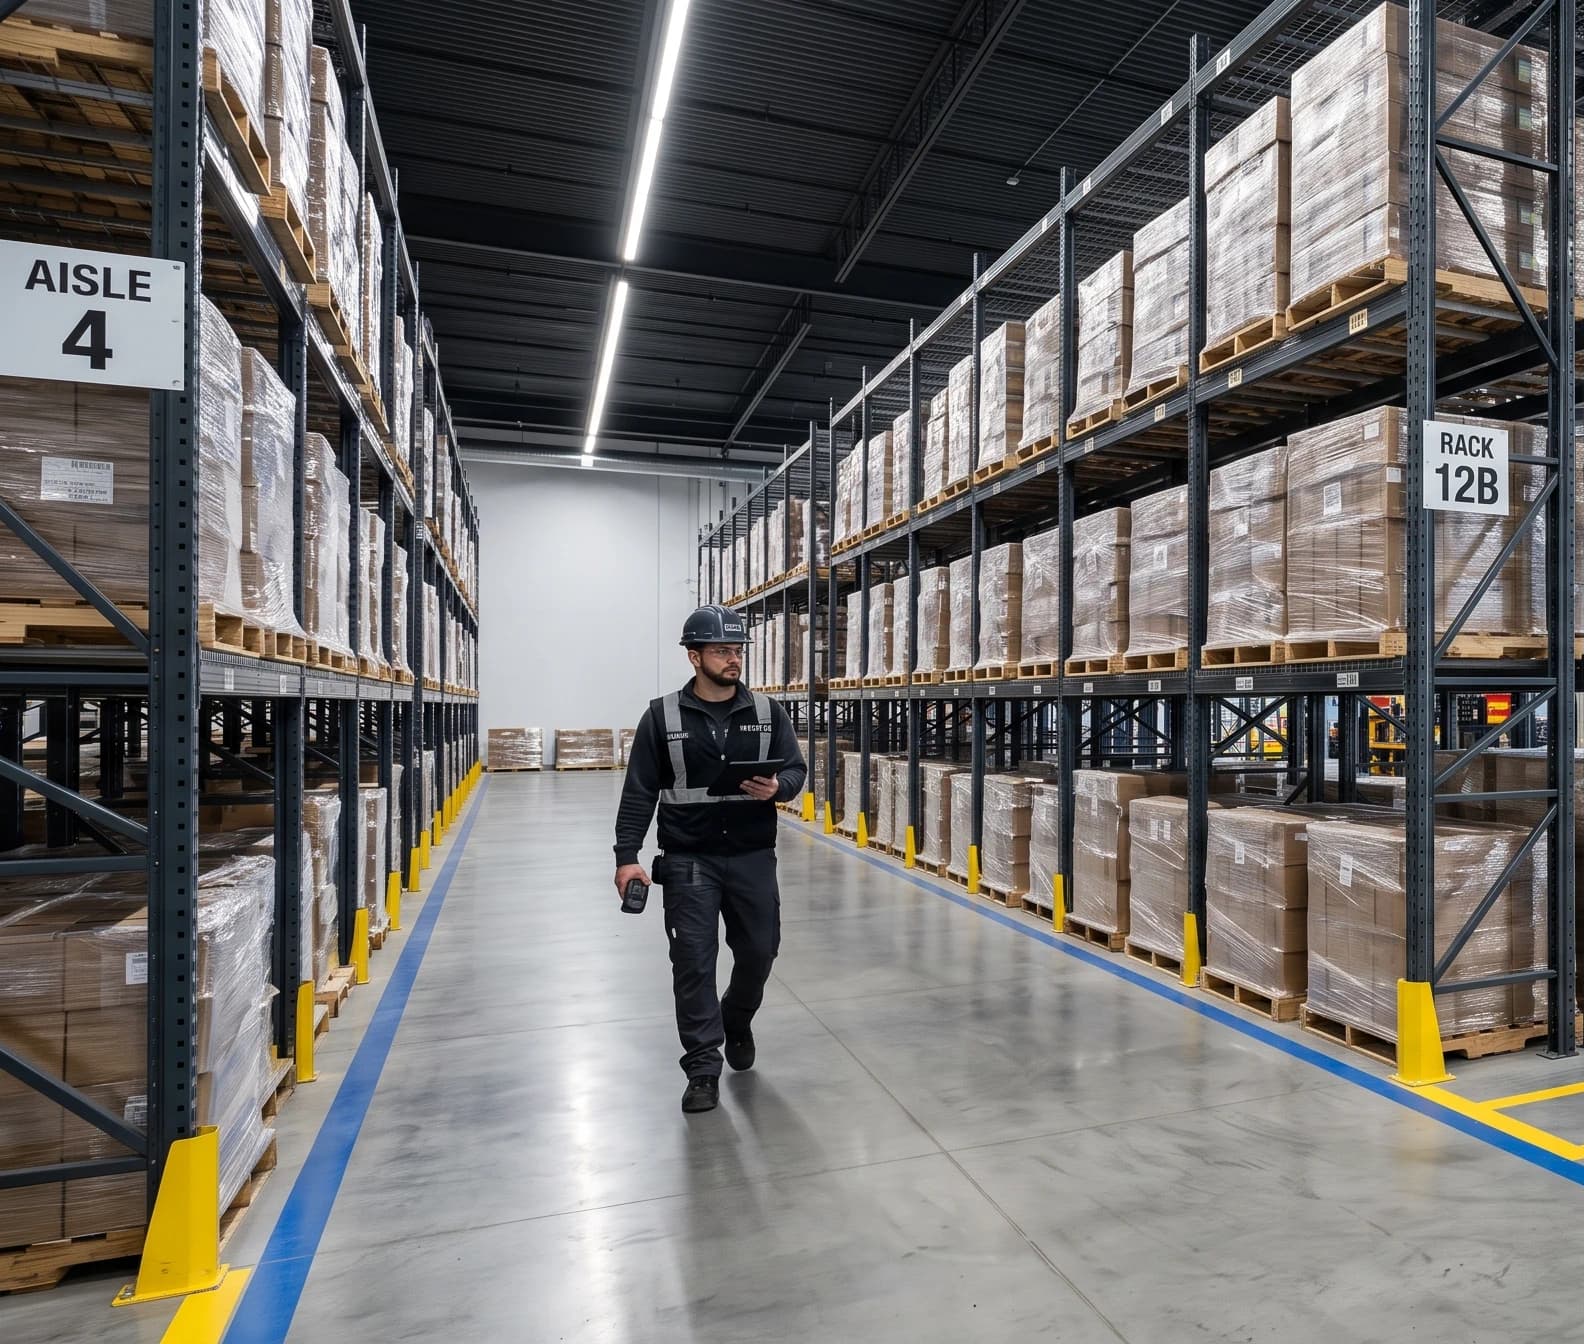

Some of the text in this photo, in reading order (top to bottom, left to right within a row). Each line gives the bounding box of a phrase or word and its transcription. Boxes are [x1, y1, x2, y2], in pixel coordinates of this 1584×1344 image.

[25, 259, 152, 302] AISLE
[62, 309, 113, 370] 4
[1440, 431, 1494, 459] RACK
[1435, 463, 1499, 505] 12B
